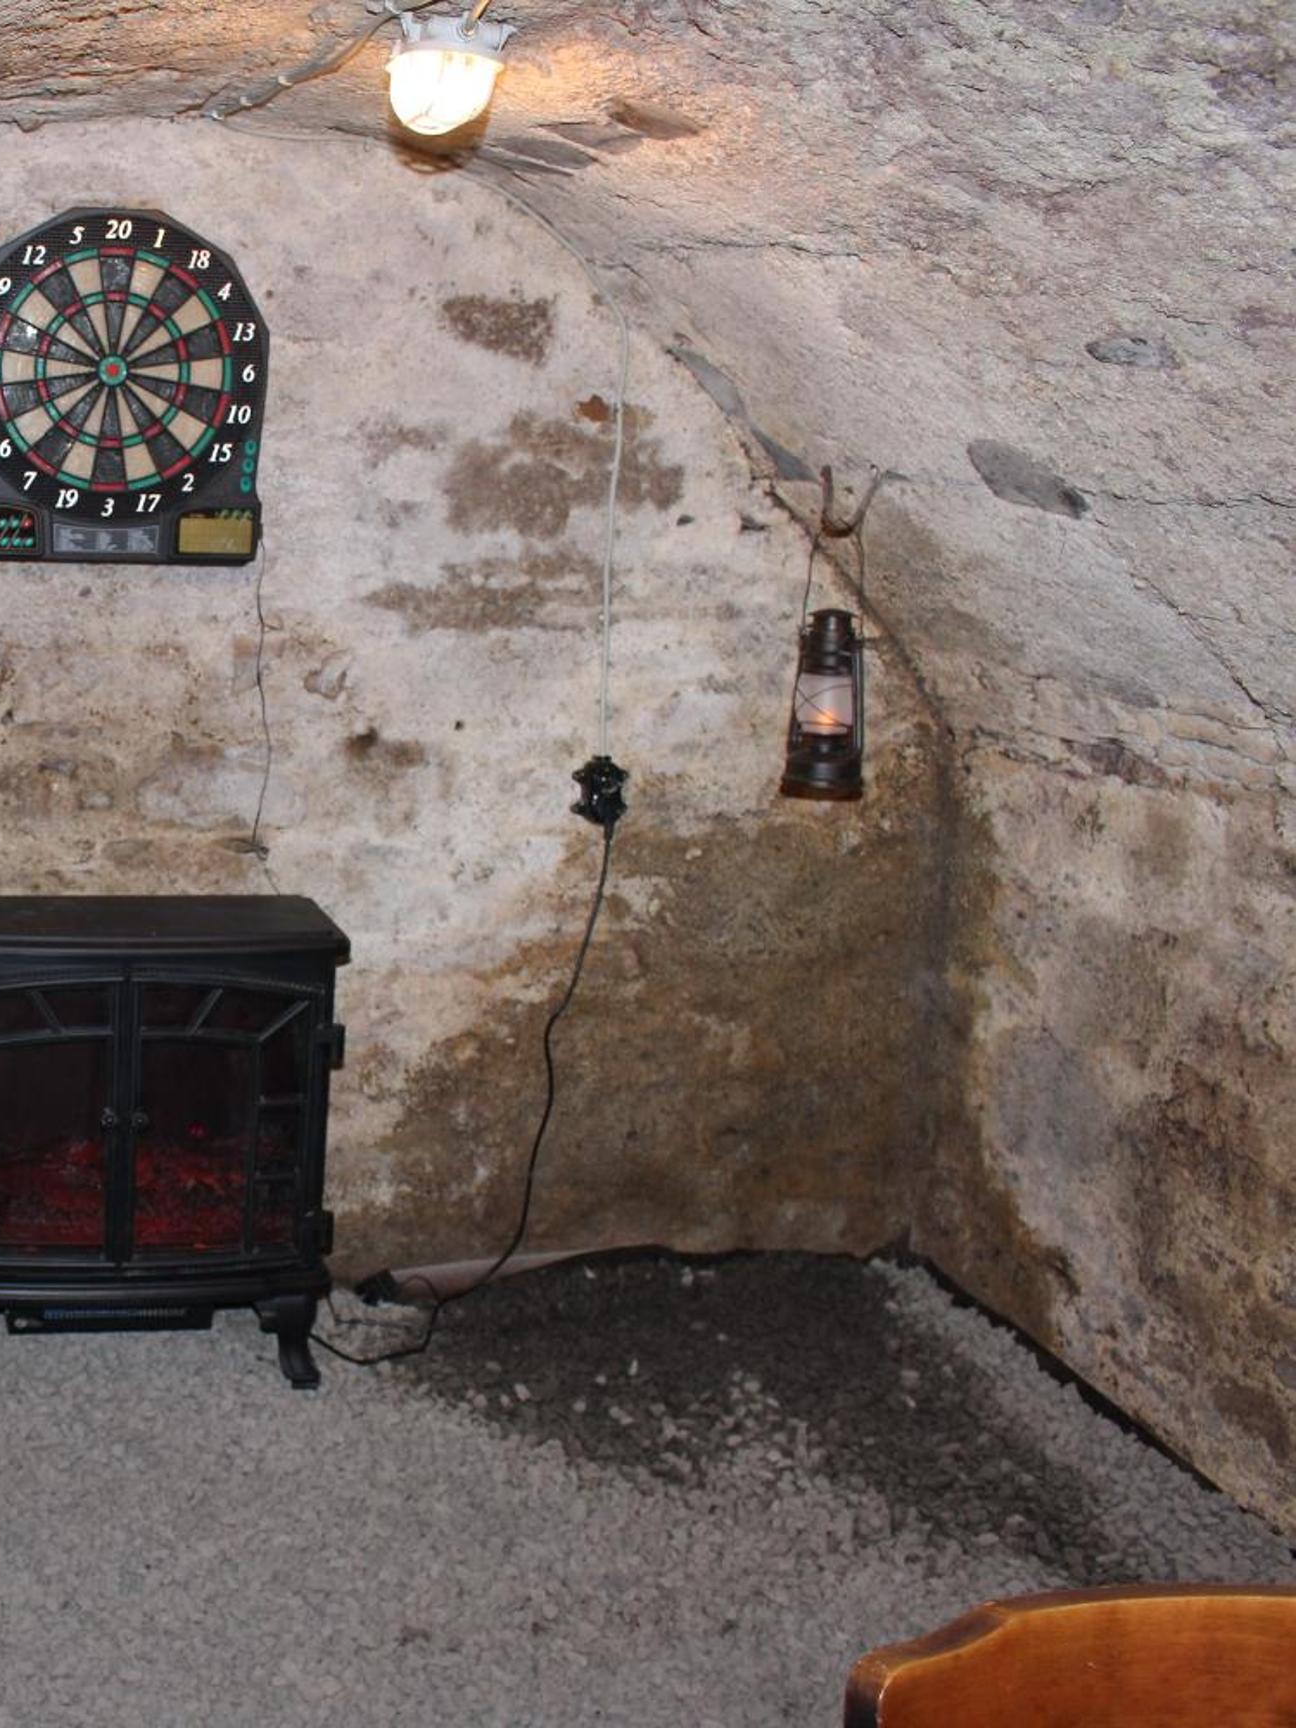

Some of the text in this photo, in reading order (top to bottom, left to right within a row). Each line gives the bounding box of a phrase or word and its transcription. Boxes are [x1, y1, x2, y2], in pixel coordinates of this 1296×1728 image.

[69, 226, 85, 245] 5
[105, 219, 132, 239] 20
[154, 229, 165, 248] 1
[22, 245, 46, 265] 12
[188, 250, 211, 269] 18
[217, 282, 232, 301] 4
[233, 322, 256, 342] 13
[242, 364, 255, 383] 6
[226, 405, 252, 424] 10
[209, 443, 232, 462] 15
[23, 471, 37, 490] 7
[182, 473, 195, 492] 2
[55, 488, 79, 508] 19
[101, 498, 115, 517] 3
[136, 494, 161, 513] 17
